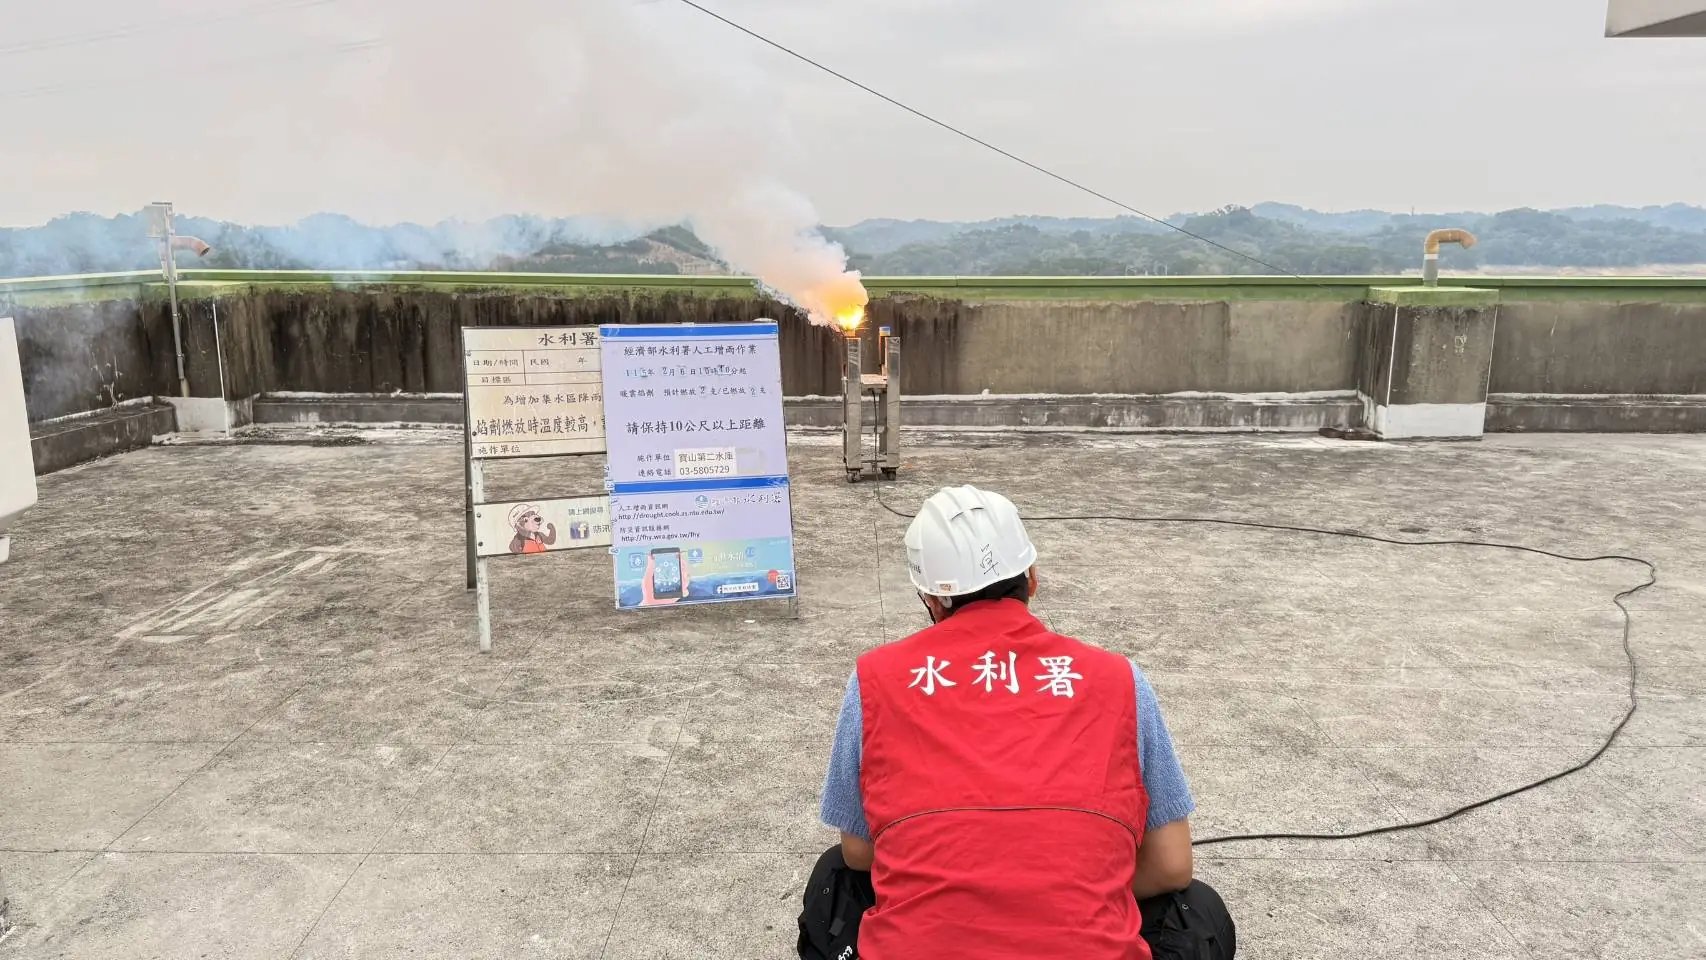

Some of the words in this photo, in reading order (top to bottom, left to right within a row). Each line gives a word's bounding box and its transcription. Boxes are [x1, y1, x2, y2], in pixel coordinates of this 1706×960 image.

[538, 332, 598, 347] 水利署
[623, 344, 759, 356] 經濟部水利署人工增雨作業
[473, 359, 519, 368] 日期/時間
[503, 393, 602, 406] 為增加集水區降雨
[476, 414, 606, 437] 焰劑燃放時溫度較高，
[626, 417, 767, 437] 請保持10公尺以上距離
[478, 444, 521, 455] 施作單位
[678, 452, 734, 463] 寶山第二水庫
[679, 465, 730, 476] 03-5805729
[907, 651, 1083, 698] 水利署
